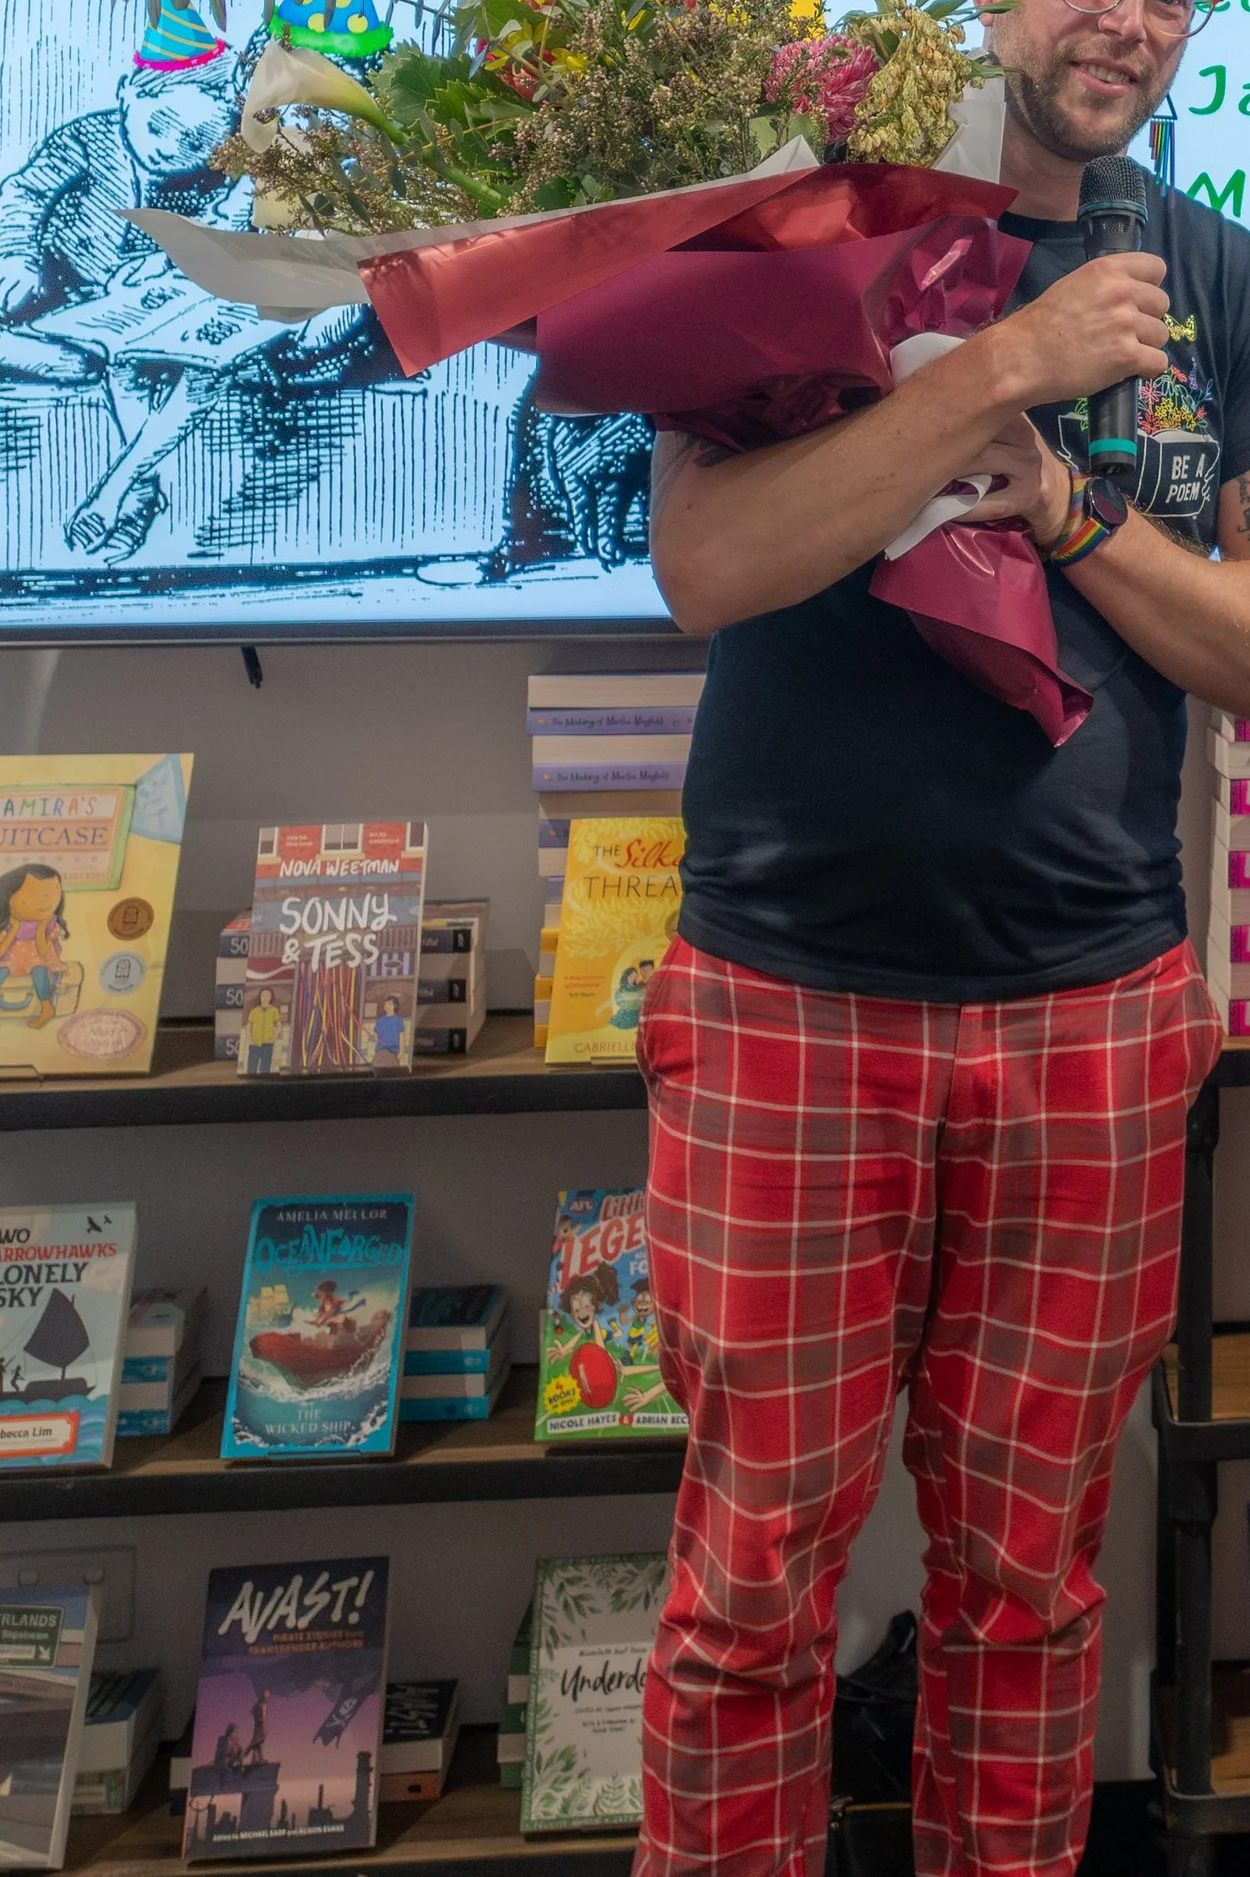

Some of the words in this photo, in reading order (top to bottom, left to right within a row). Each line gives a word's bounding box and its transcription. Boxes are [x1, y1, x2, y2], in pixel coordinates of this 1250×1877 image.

[1172, 455, 1190, 480] BE
[1196, 453, 1205, 477] A
[1165, 481, 1200, 504] POEM
[3, 796, 97, 817] AMIRA'S
[595, 845, 621, 858] THE
[279, 858, 321, 878] NOVA
[325, 858, 400, 877] WEETMAN
[279, 892, 398, 935] SONNY
[281, 938, 301, 964] &
[303, 933, 380, 973] TESS
[277, 1211, 328, 1223] AMELIA
[332, 1209, 388, 1222] MELLOR
[32, 1426, 53, 1438] Lim
[550, 1420, 585, 1430] NICOLE
[588, 1416, 617, 1428] HAYES
[637, 1416, 669, 1425] ADRIAN
[218, 1571, 374, 1643] AVAST!
